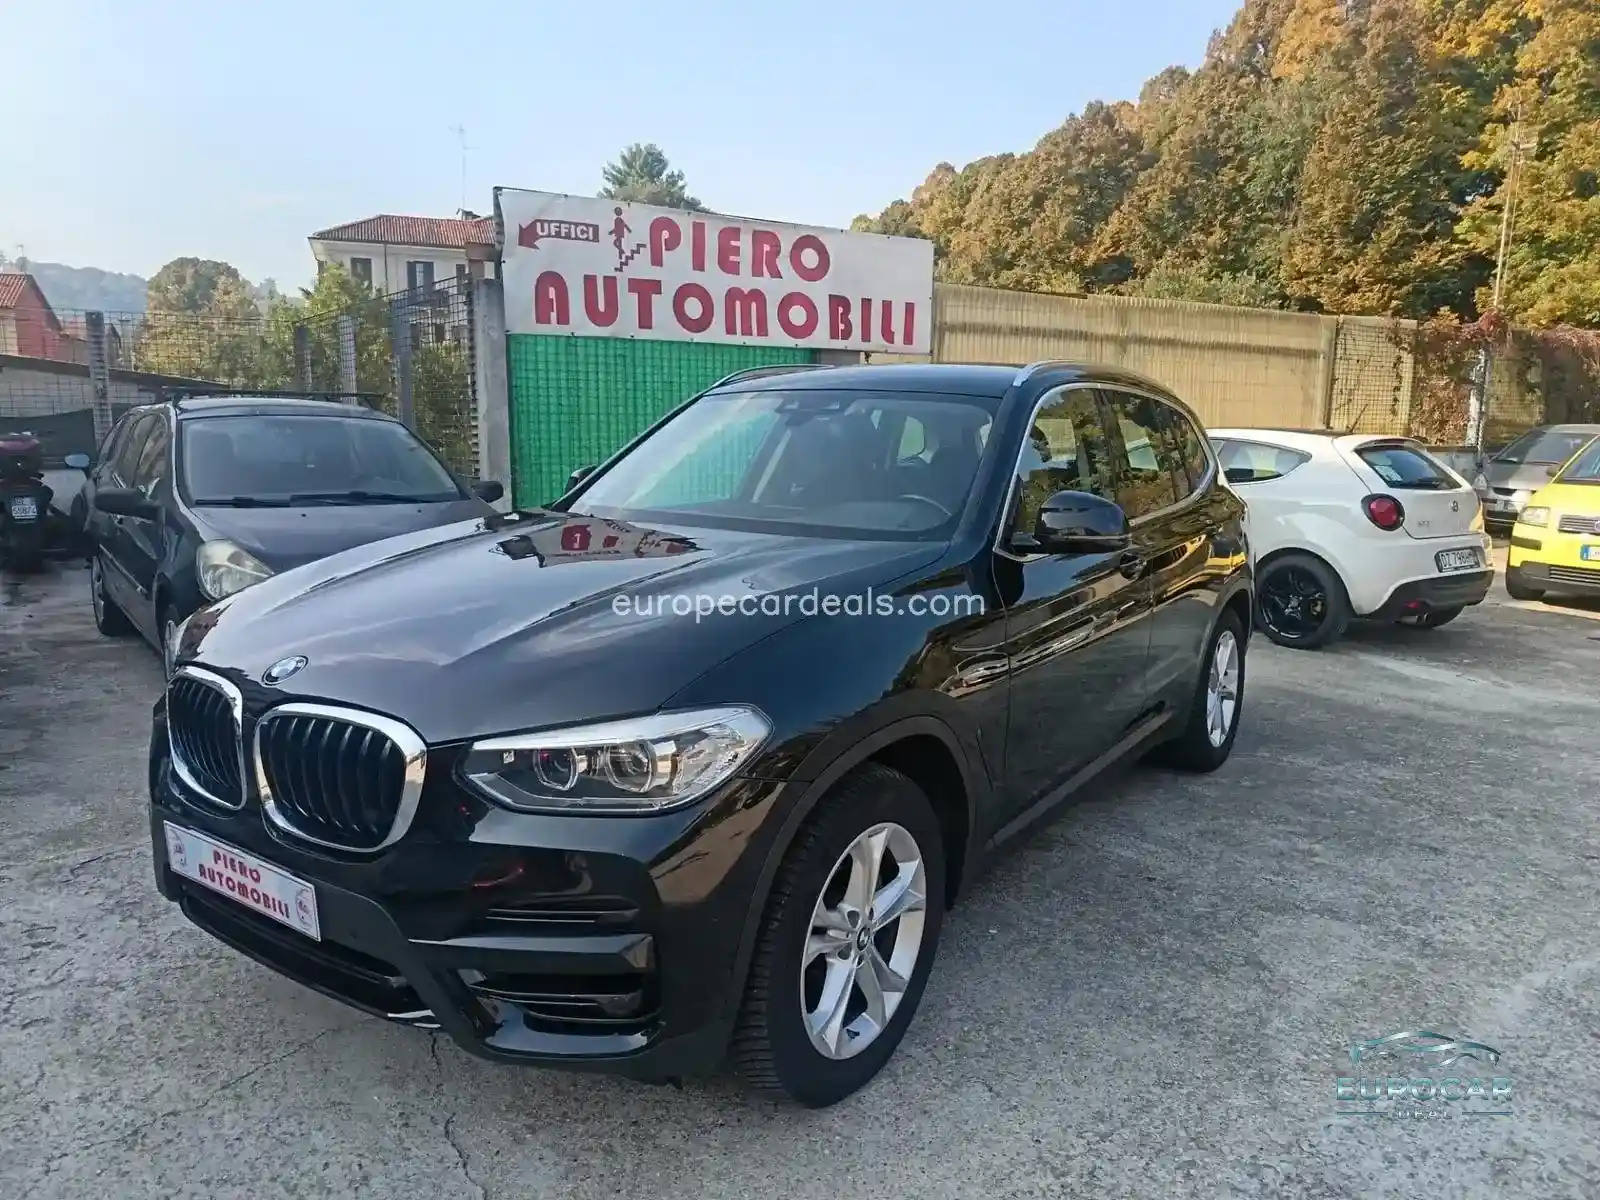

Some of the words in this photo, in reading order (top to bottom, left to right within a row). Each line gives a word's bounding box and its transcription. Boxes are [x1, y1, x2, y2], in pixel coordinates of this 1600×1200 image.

[536, 221, 594, 240] UFFICI
[649, 215, 831, 282] PIERO
[534, 270, 916, 346] AUTOMOBILI
[198, 863, 290, 919] AUTOMOBILI
[213, 850, 261, 883] PIERO
